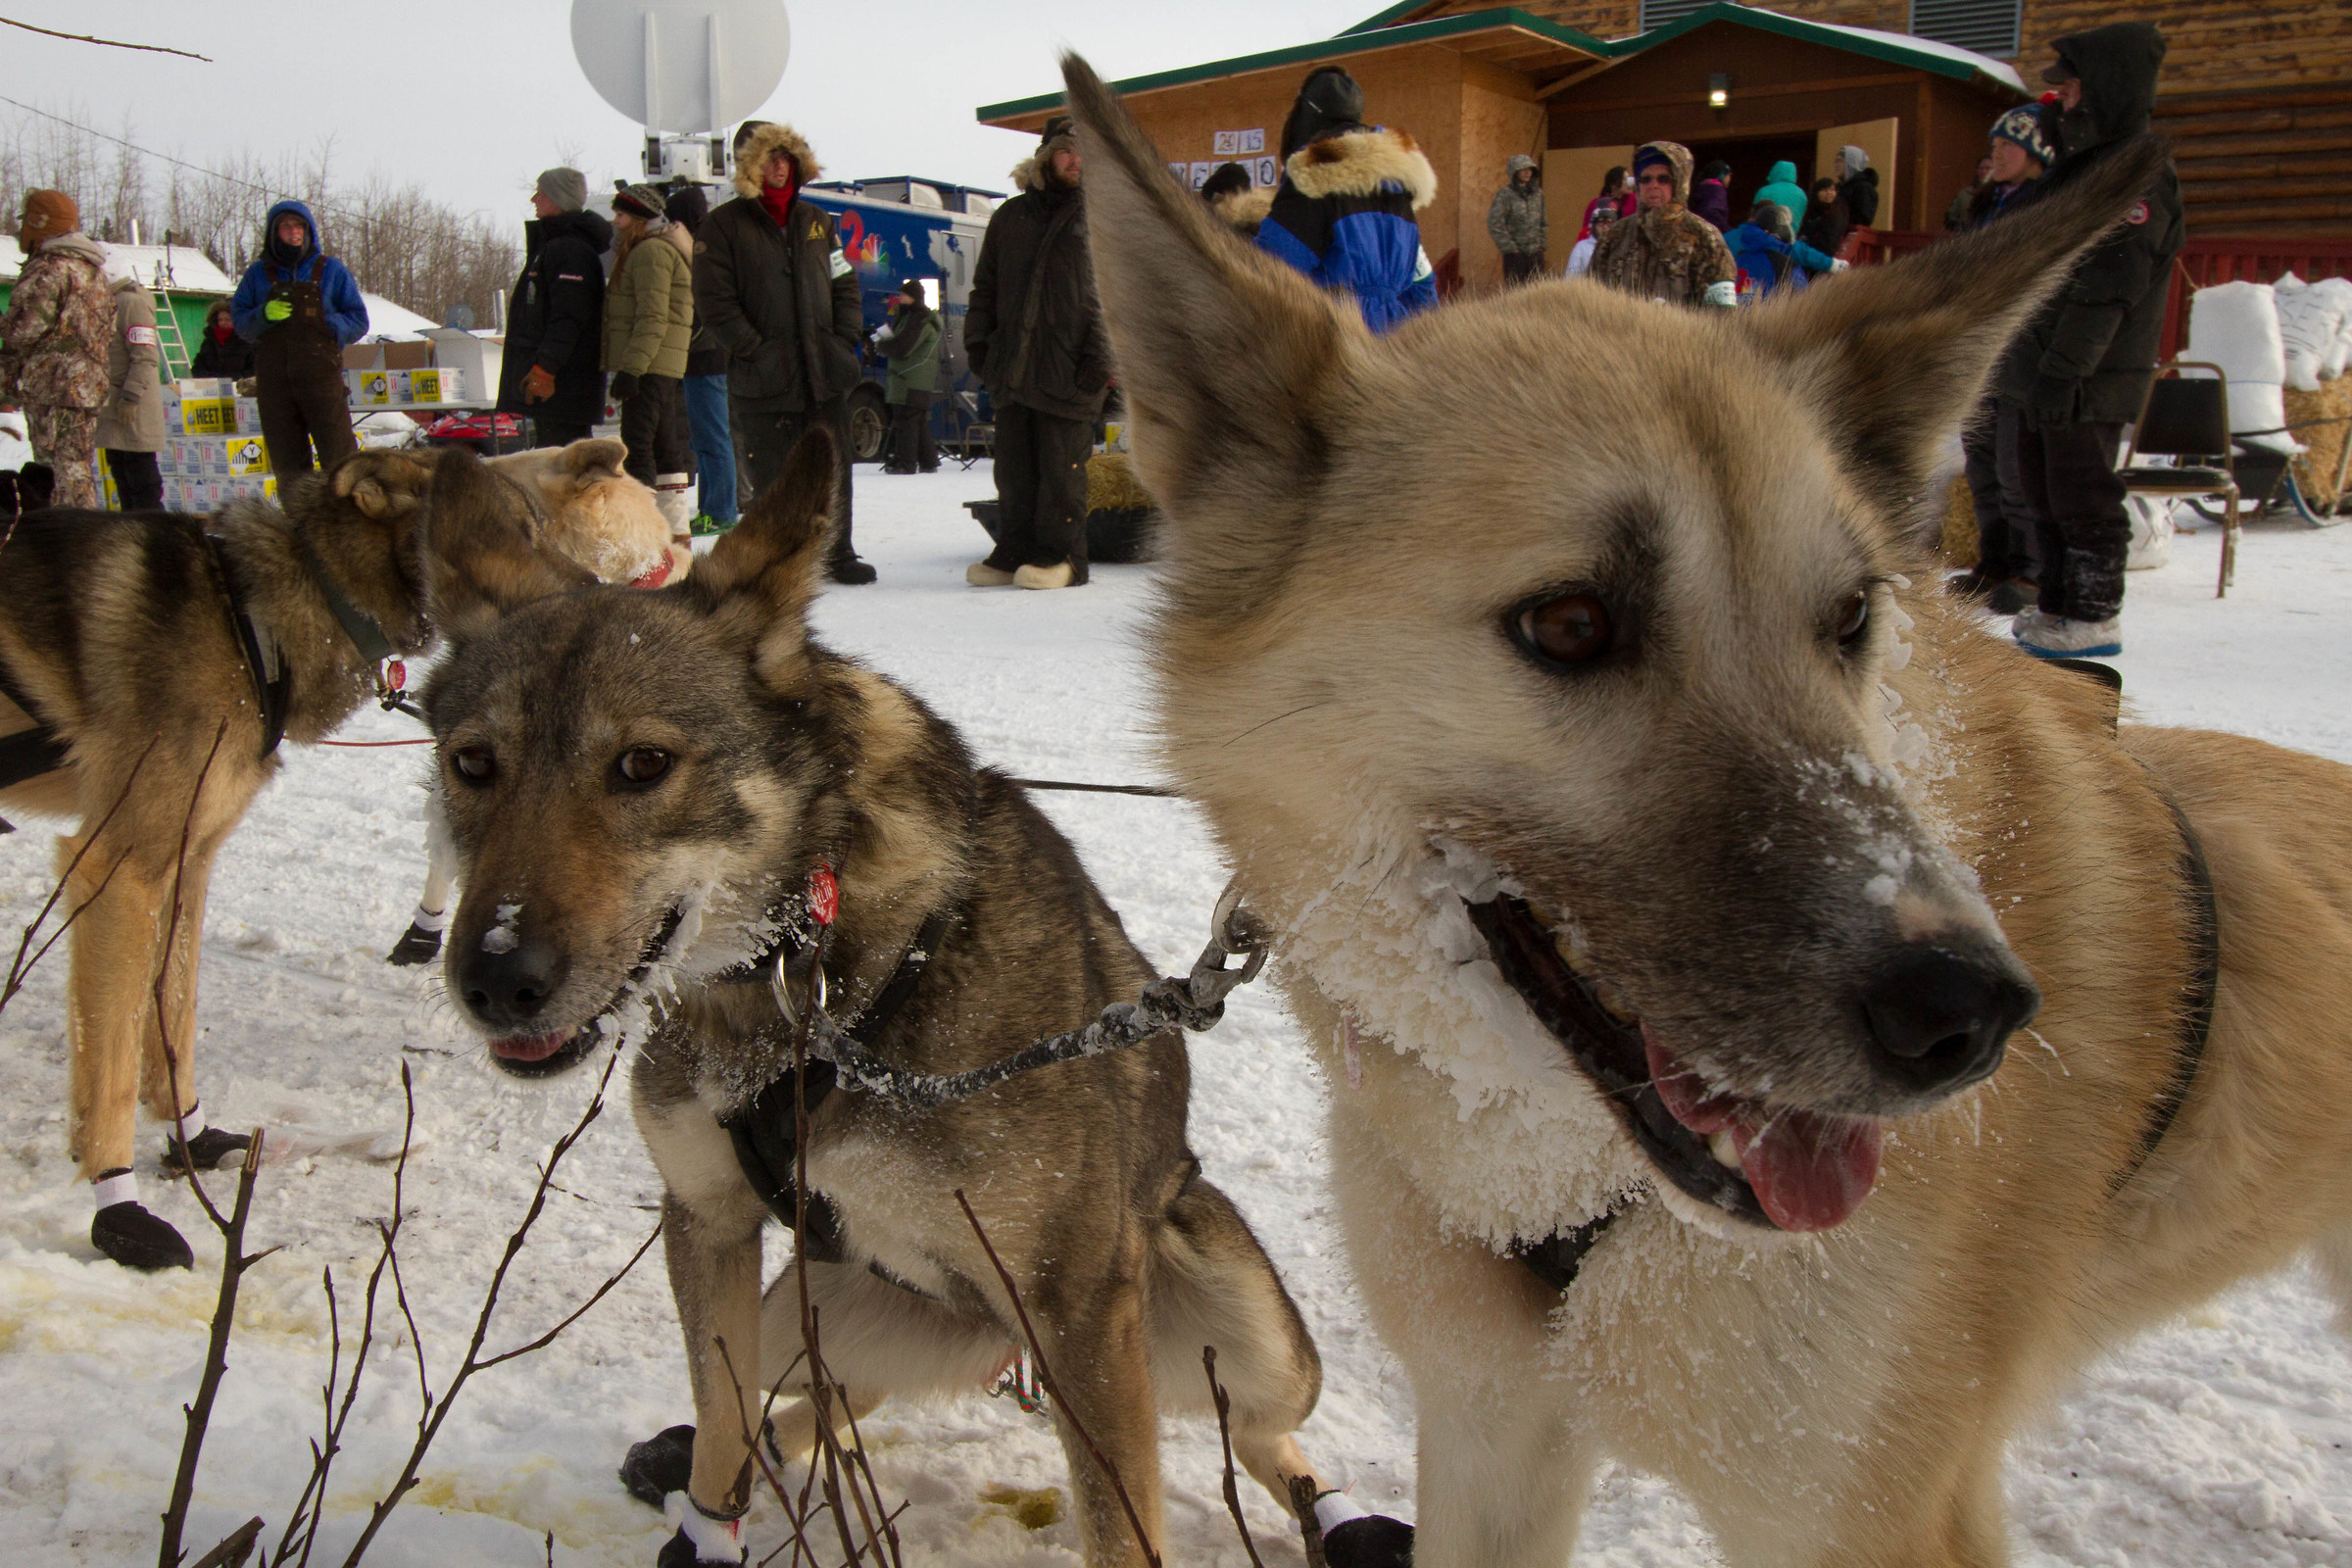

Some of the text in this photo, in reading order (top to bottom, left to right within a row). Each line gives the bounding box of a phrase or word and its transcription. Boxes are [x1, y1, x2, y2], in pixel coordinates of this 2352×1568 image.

[841, 209, 864, 261] 2
[420, 378, 439, 394] HEET
[195, 407, 220, 425] HEET
[221, 406, 236, 424] EET
